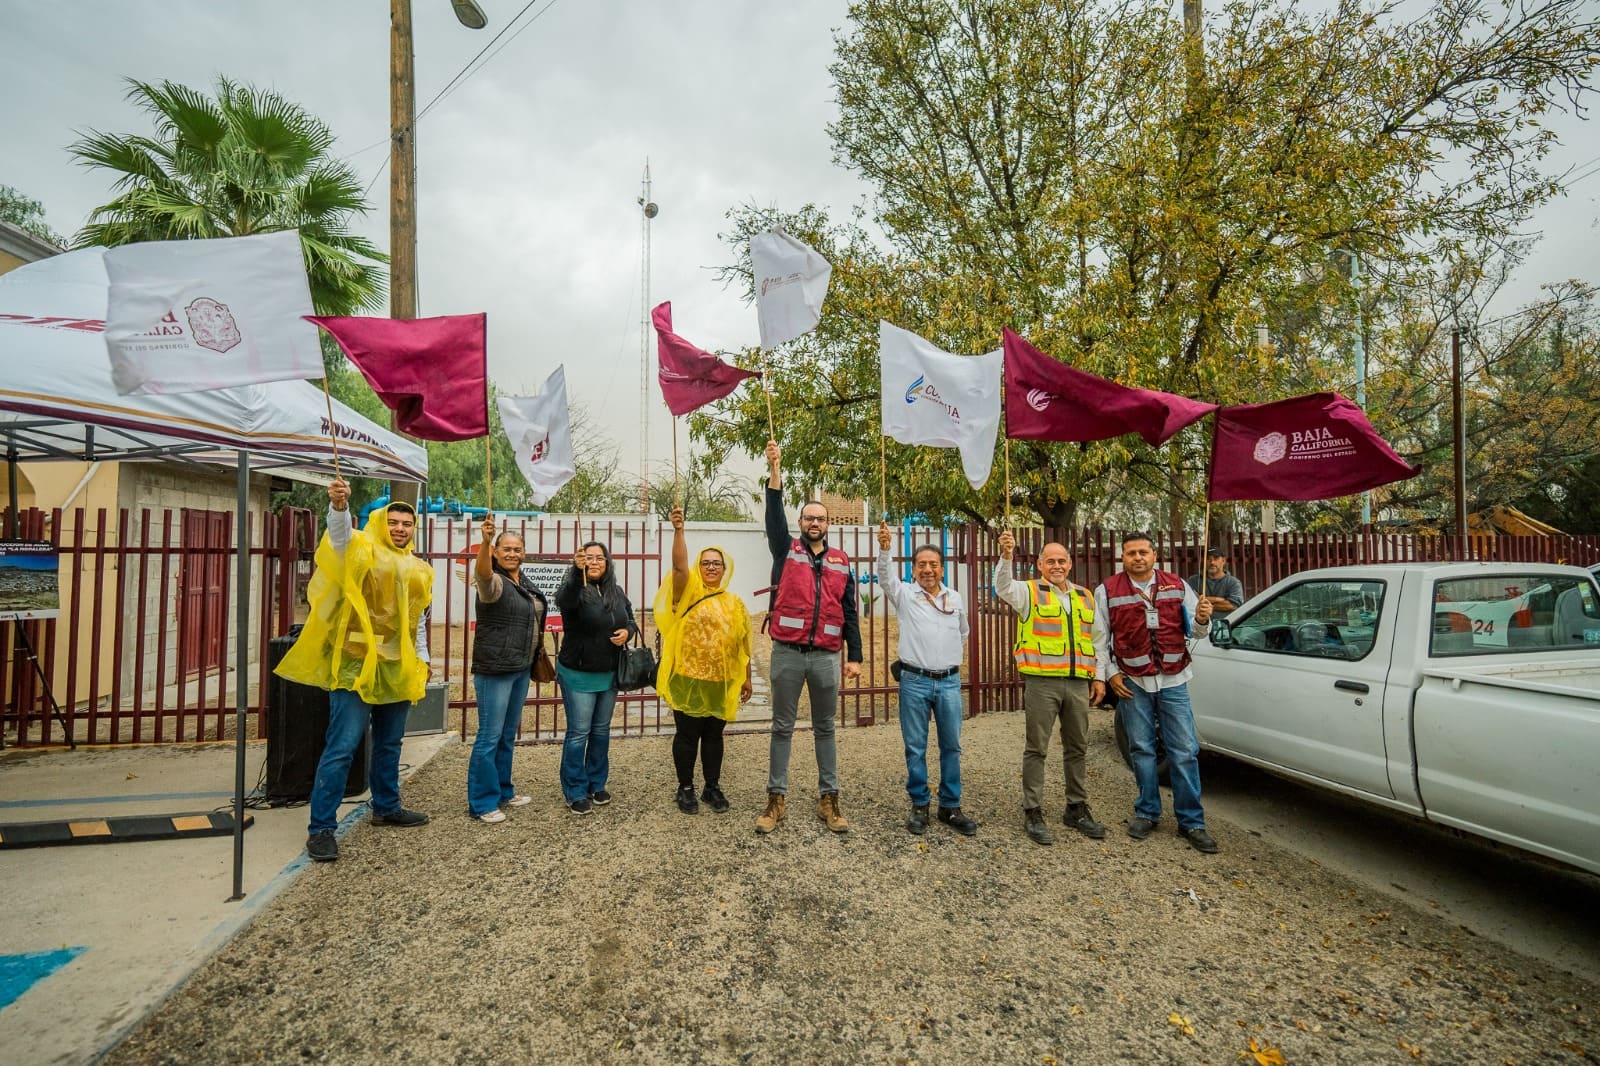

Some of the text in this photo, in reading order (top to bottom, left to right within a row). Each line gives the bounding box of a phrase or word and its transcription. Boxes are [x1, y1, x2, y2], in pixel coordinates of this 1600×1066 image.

[1291, 427, 1333, 444] BAJA
[1291, 437, 1352, 452] CALIFORNIA
[1473, 619, 1495, 636] 24
